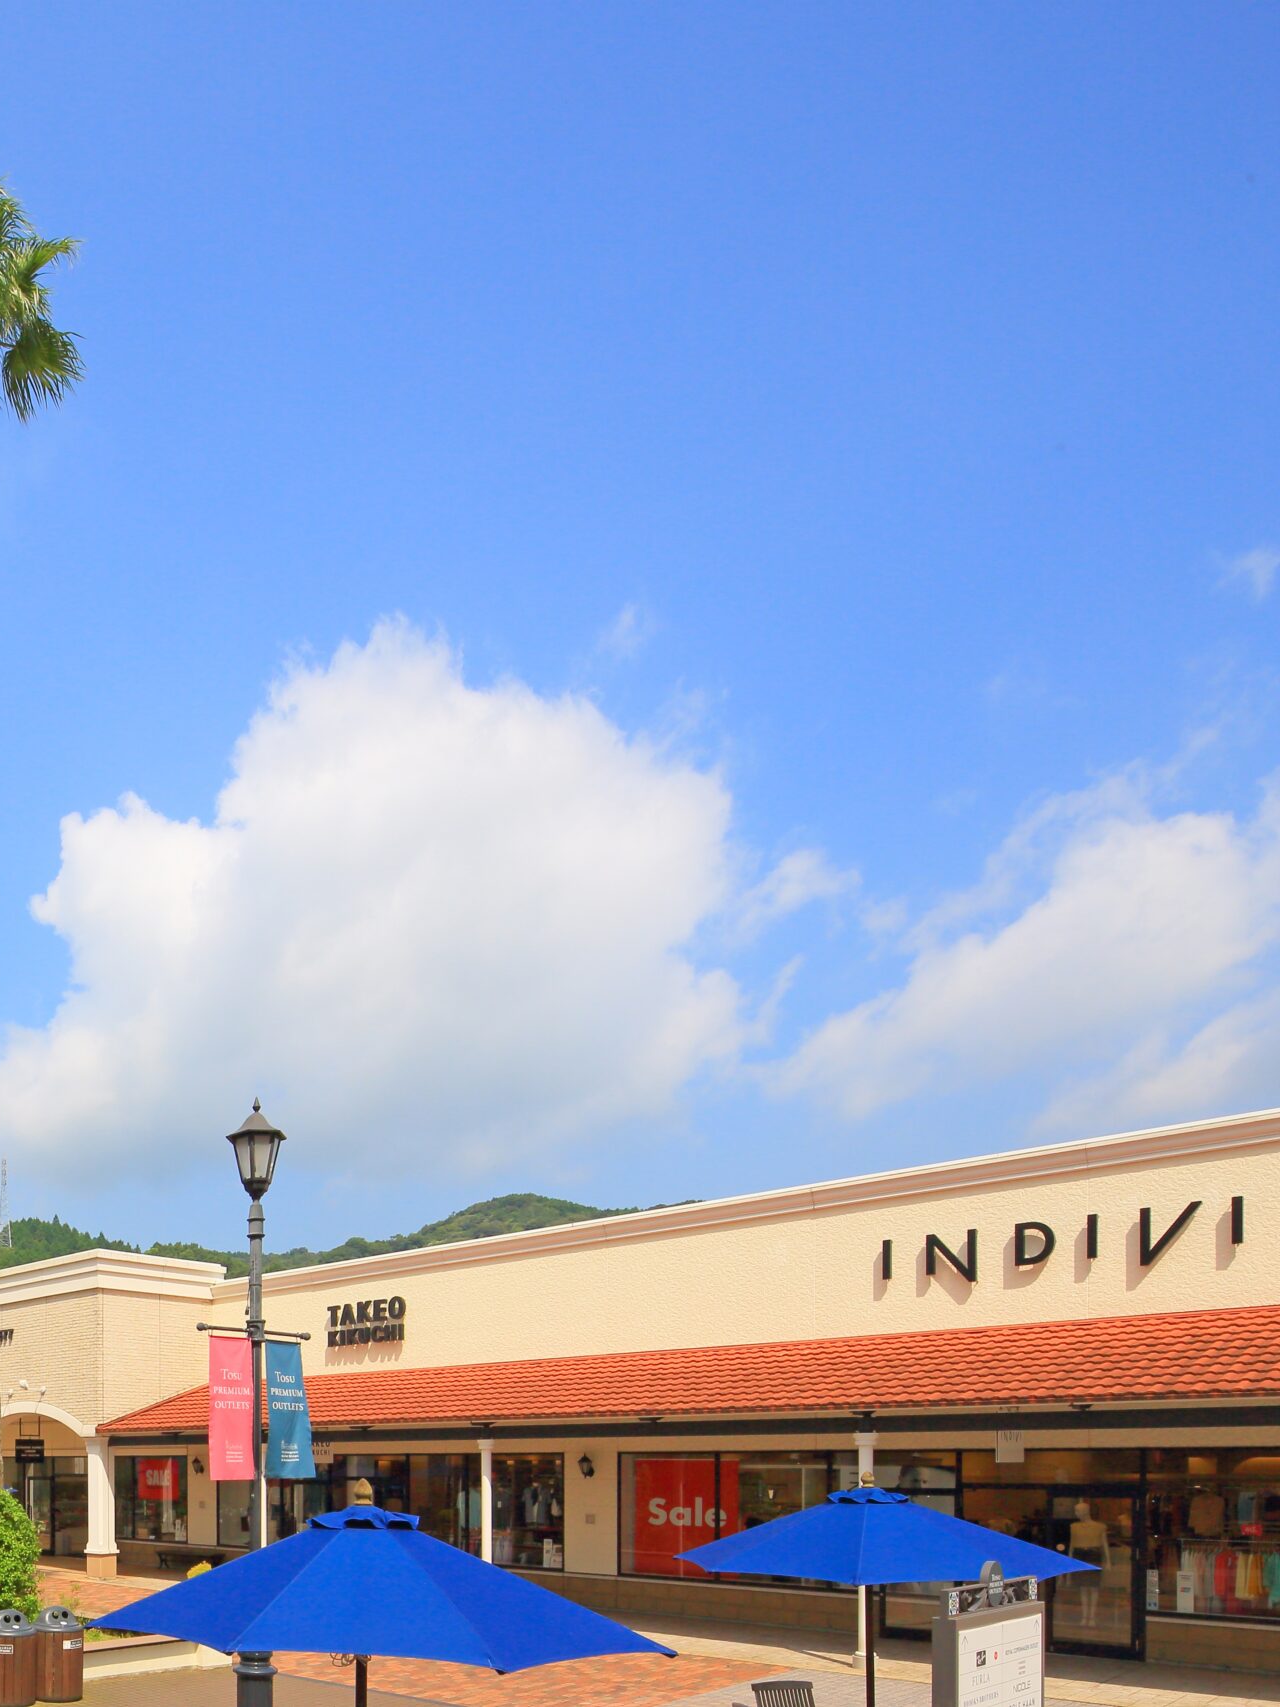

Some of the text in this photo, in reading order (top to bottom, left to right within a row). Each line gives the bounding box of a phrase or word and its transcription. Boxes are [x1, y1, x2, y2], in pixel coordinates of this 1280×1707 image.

[882, 1195, 1244, 1283] INDIVI
[327, 1296, 406, 1327] TAKEO
[327, 1324, 405, 1348] KIKUCHI
[213, 1386, 250, 1395] PREMIUM
[270, 1387, 303, 1397] PREMIUM
[214, 1401, 250, 1410] OUTLETS
[272, 1401, 304, 1411] OUTLETS
[145, 1469, 171, 1486] SALE
[648, 1496, 728, 1528] Sale
[971, 1673, 990, 1687] FURLA
